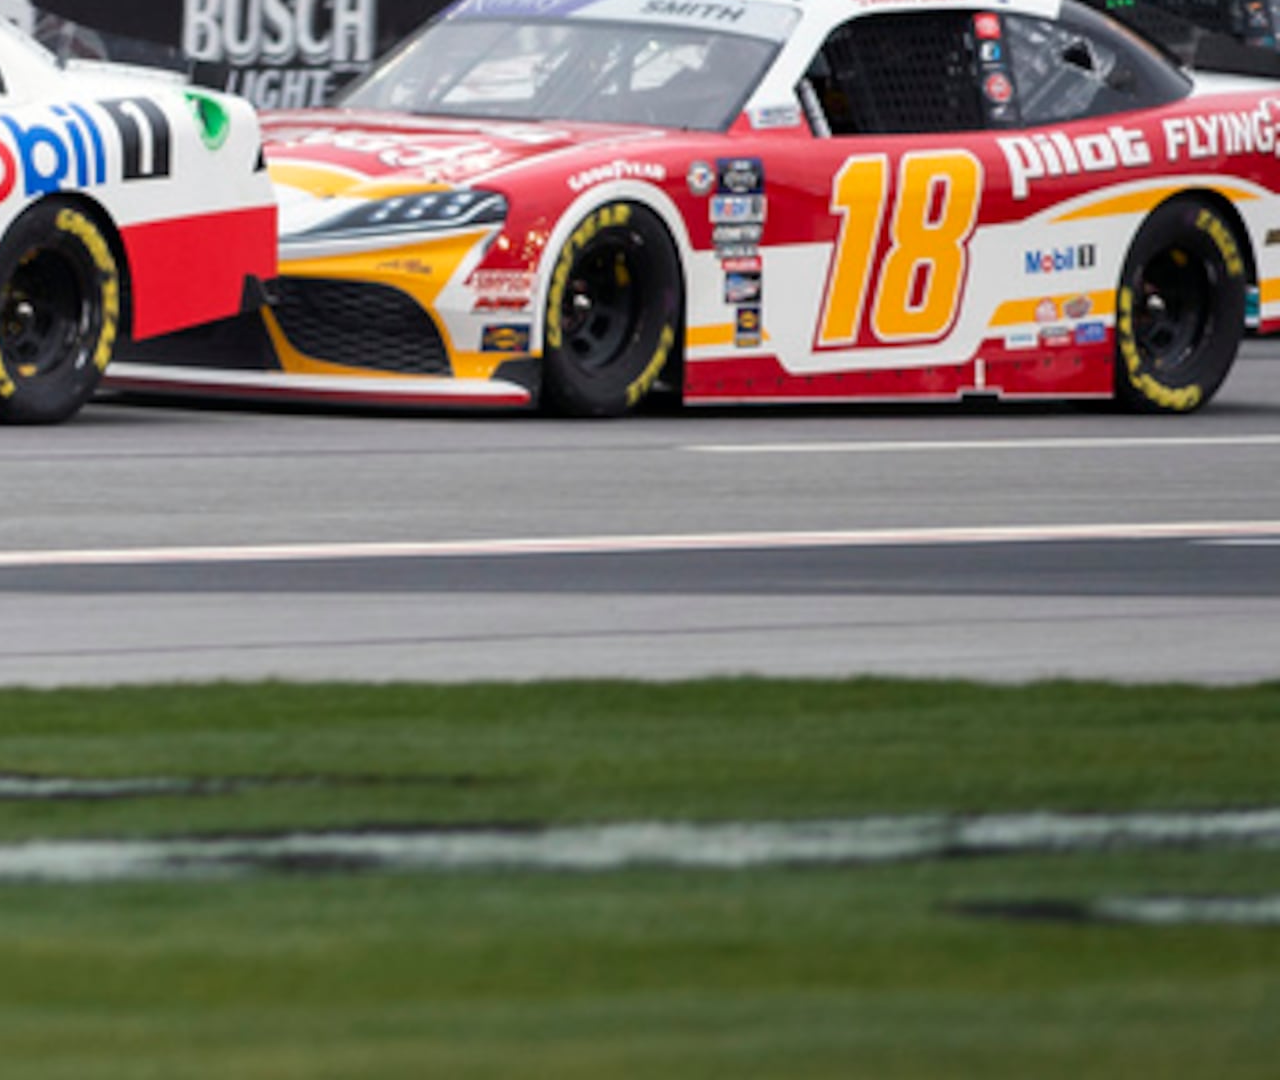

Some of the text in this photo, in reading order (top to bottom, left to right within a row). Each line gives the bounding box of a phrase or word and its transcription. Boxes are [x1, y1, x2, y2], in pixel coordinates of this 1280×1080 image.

[100, 96, 172, 180] 1
[1161, 111, 1275, 162] FLYING
[568, 160, 666, 190] GOODYEAR
[820, 155, 980, 345] 18
[1025, 248, 1074, 273] Mobil
